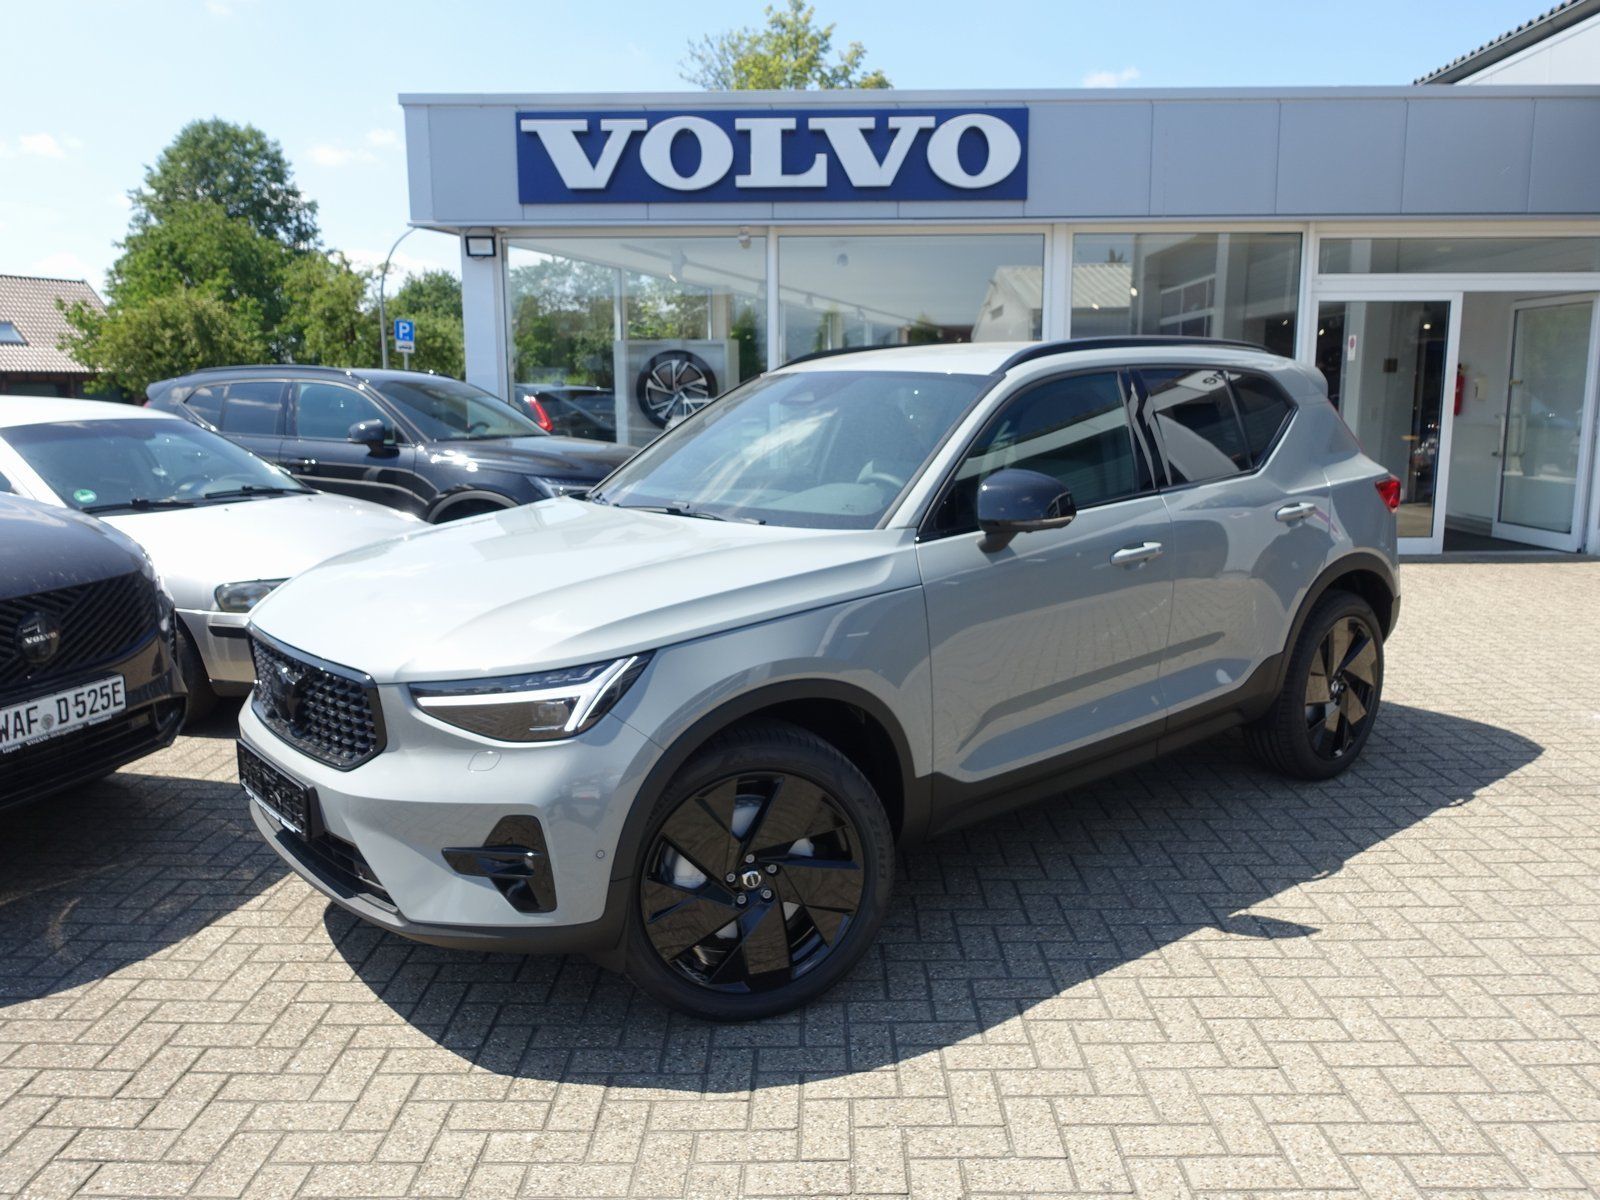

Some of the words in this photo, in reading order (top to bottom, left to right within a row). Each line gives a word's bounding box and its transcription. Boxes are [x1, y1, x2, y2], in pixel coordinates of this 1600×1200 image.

[520, 113, 1022, 191] VOLVO
[398, 322, 411, 339] P
[25, 631, 57, 644] VOLVO
[0, 705, 38, 744] WAF
